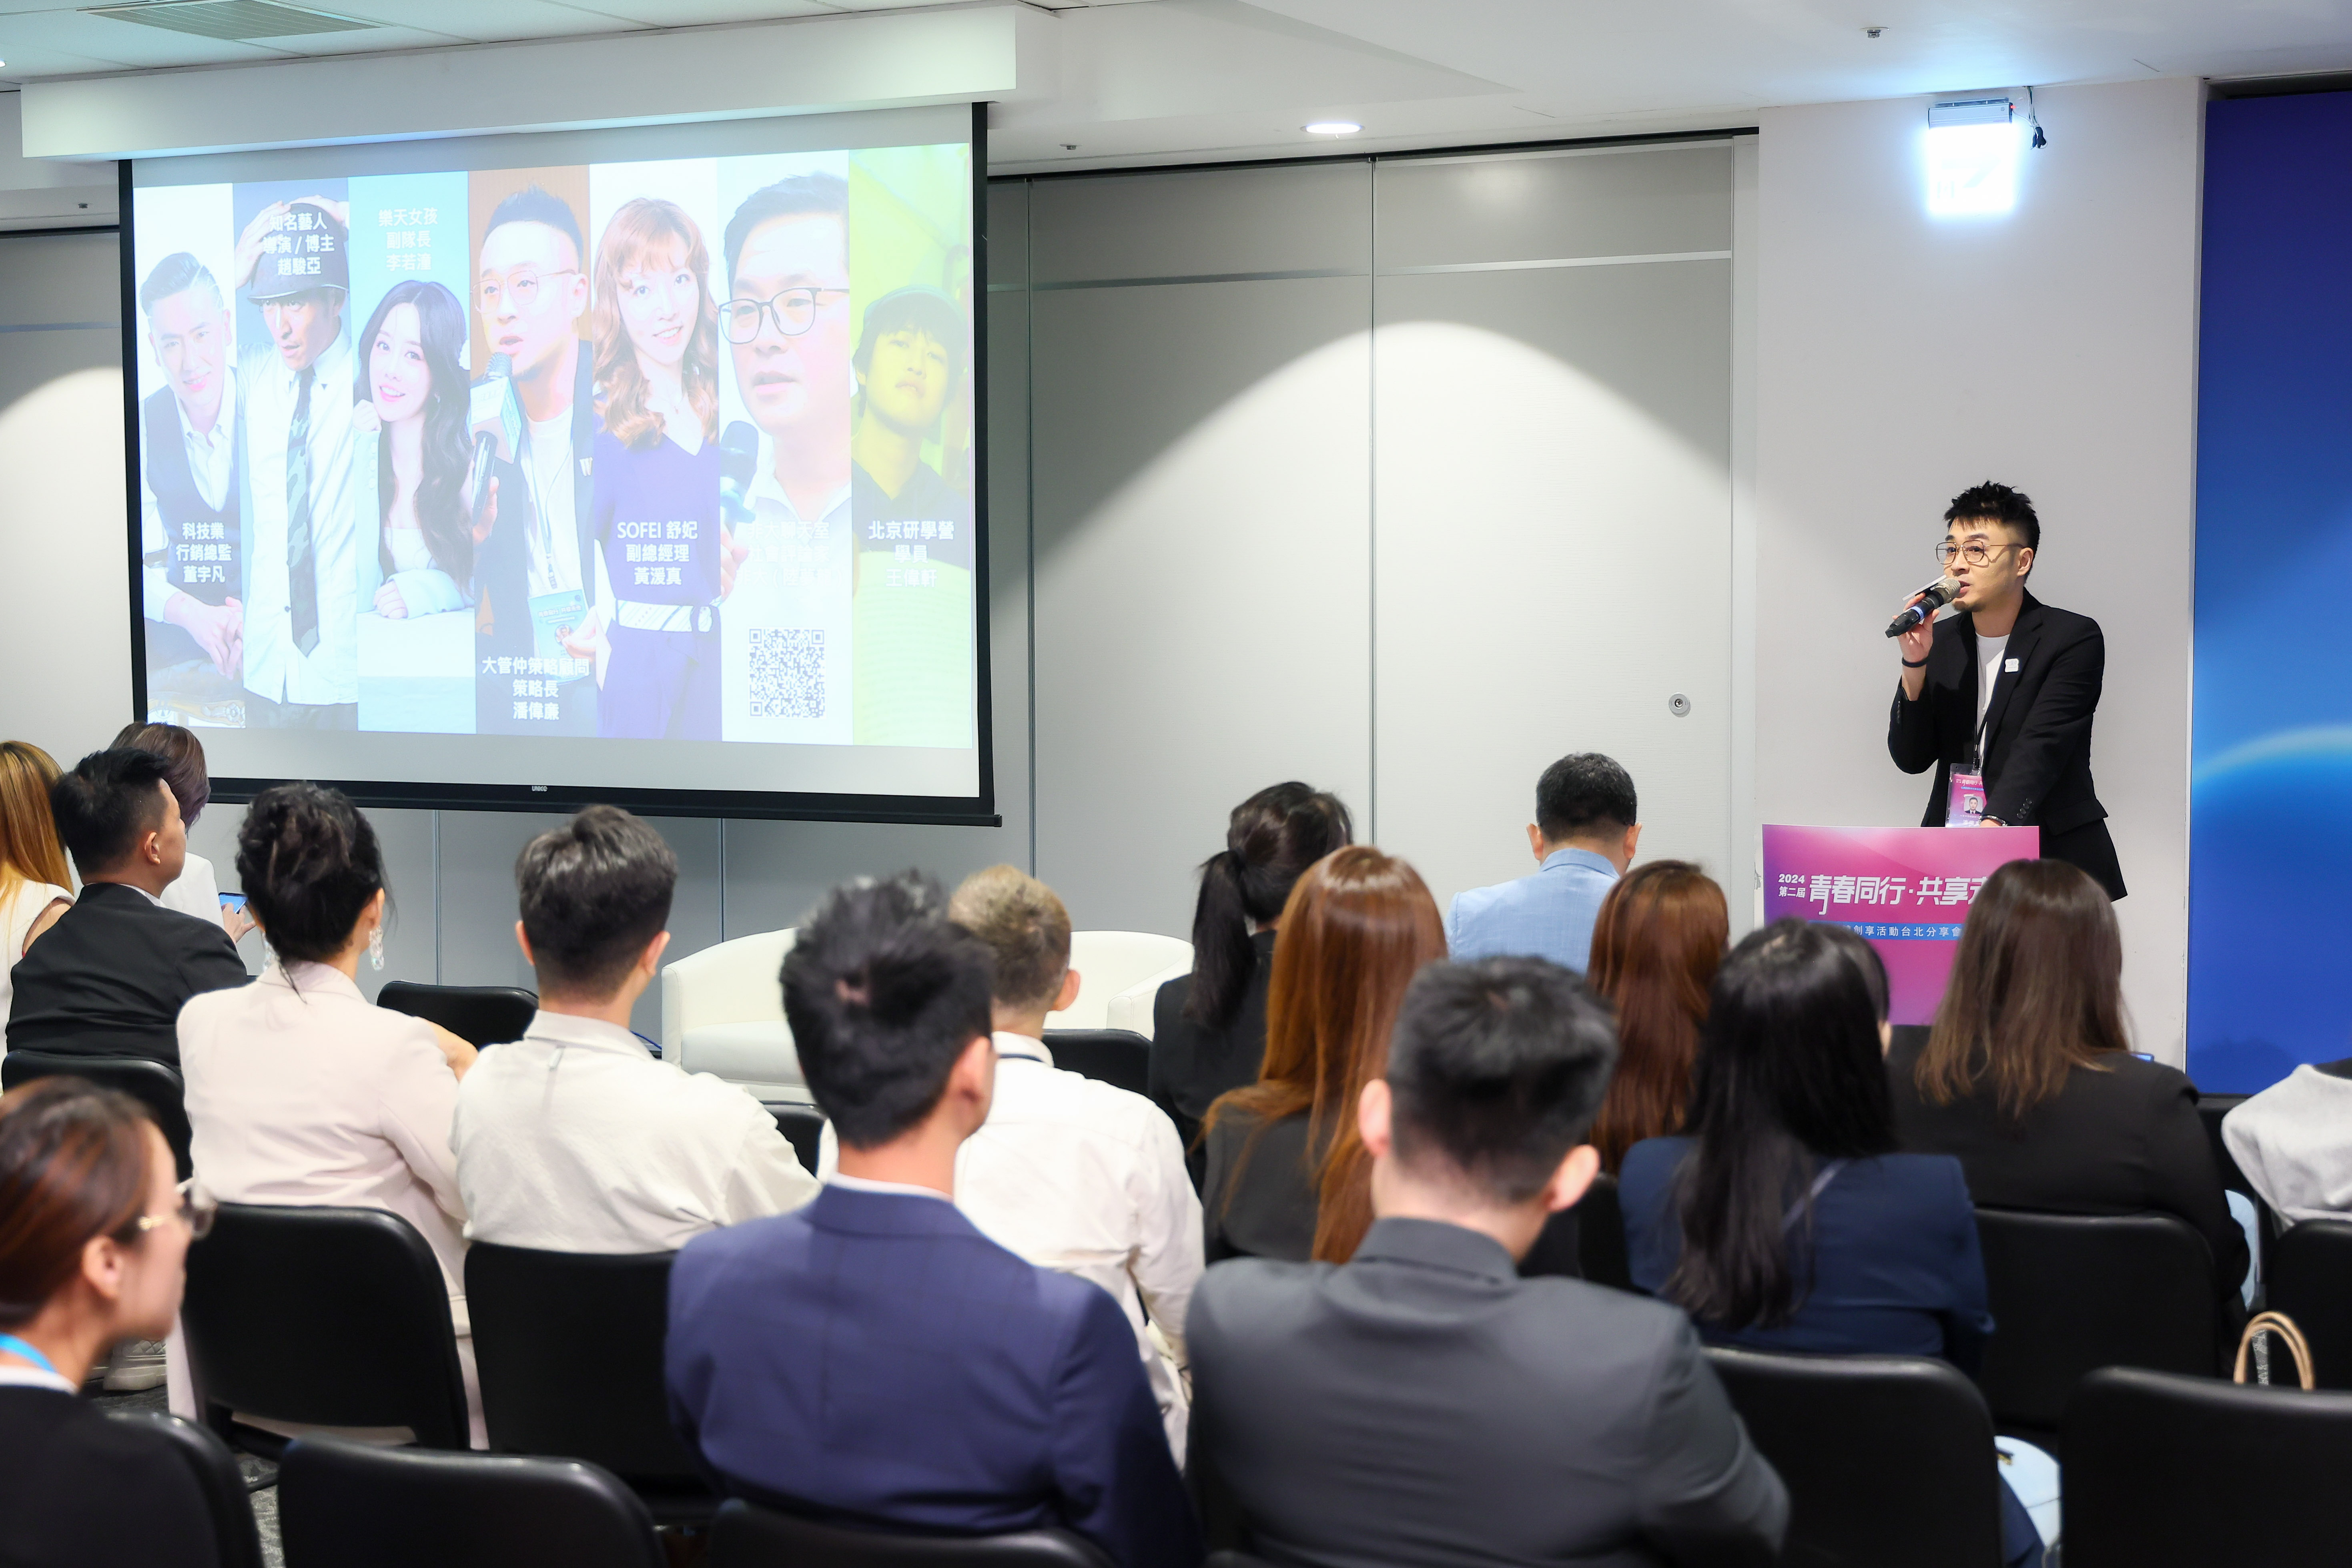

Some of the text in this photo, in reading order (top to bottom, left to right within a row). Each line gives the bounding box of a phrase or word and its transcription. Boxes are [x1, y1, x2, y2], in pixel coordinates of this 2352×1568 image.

[269, 212, 328, 232] 知名藝人
[378, 207, 438, 227] 樂天女孩
[305, 234, 335, 253] 博主
[386, 230, 431, 250] 副隊長
[277, 257, 321, 276] 趙駿亞
[386, 253, 432, 271] 李若潼
[182, 521, 225, 540] 科技業
[617, 520, 698, 539] SOFEI 舒妃
[748, 521, 830, 539] 非大聊天室
[868, 520, 954, 540] 北京研學營
[176, 543, 232, 561] 行銷總監
[626, 543, 690, 562] 副總經理
[894, 544, 928, 563] 學員
[183, 565, 226, 583] 董宇凡
[886, 568, 937, 587] 王偉軒
[481, 656, 590, 676] 大管仲策略顧問
[512, 679, 559, 698] 策略長
[512, 701, 559, 720] 潘偉廉
[1778, 874, 1805, 884] 2024
[1778, 885, 1805, 898] 第二屆
[1844, 924, 1963, 938] 創享活動台北分享會
